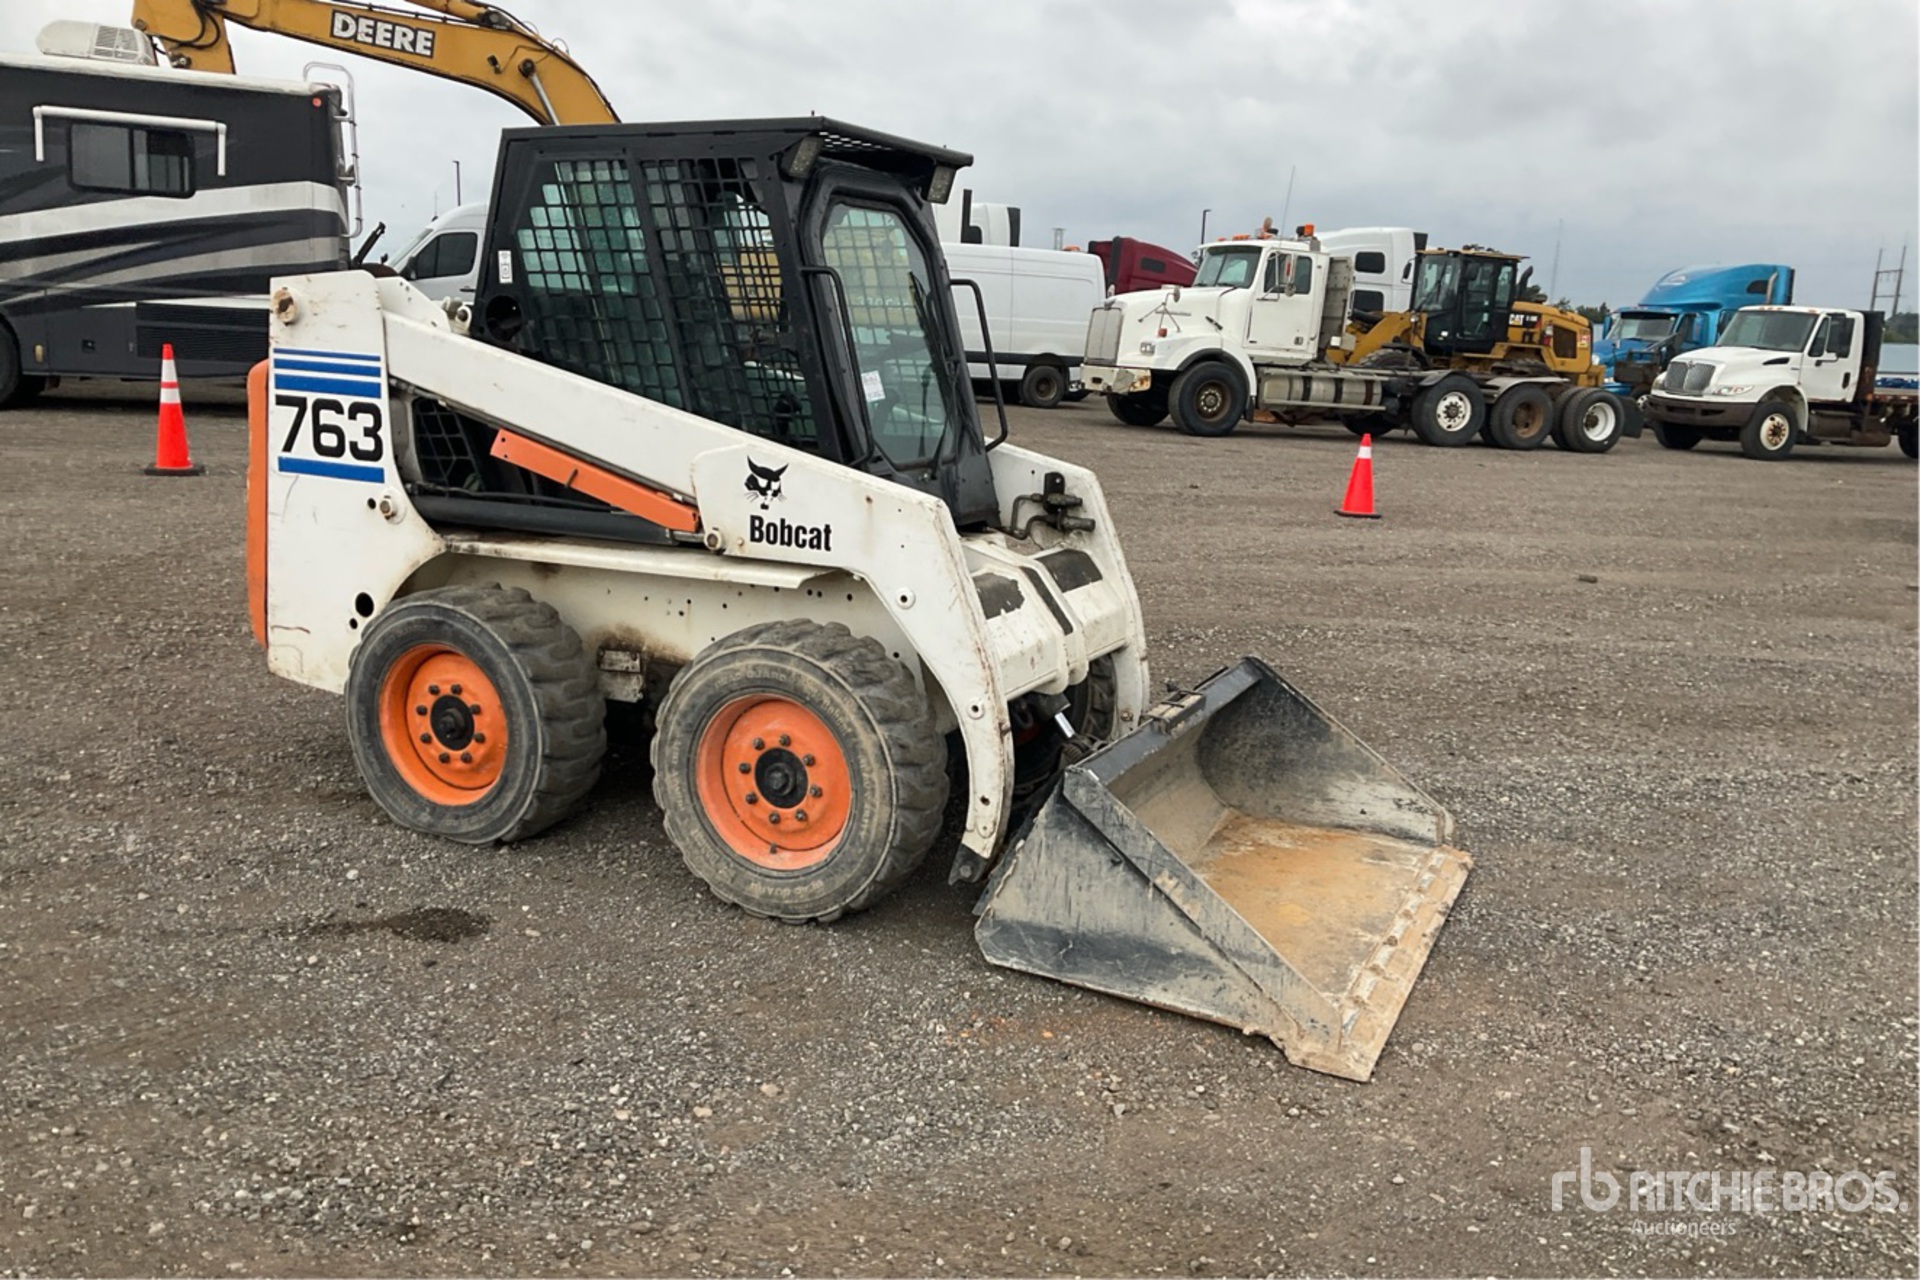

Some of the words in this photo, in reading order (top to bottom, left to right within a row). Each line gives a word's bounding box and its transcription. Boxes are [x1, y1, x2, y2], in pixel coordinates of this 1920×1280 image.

[332, 11, 434, 56] DEERE
[1508, 313, 1525, 326] CAT
[275, 394, 384, 462] 763
[750, 514, 832, 552] Bobcat
